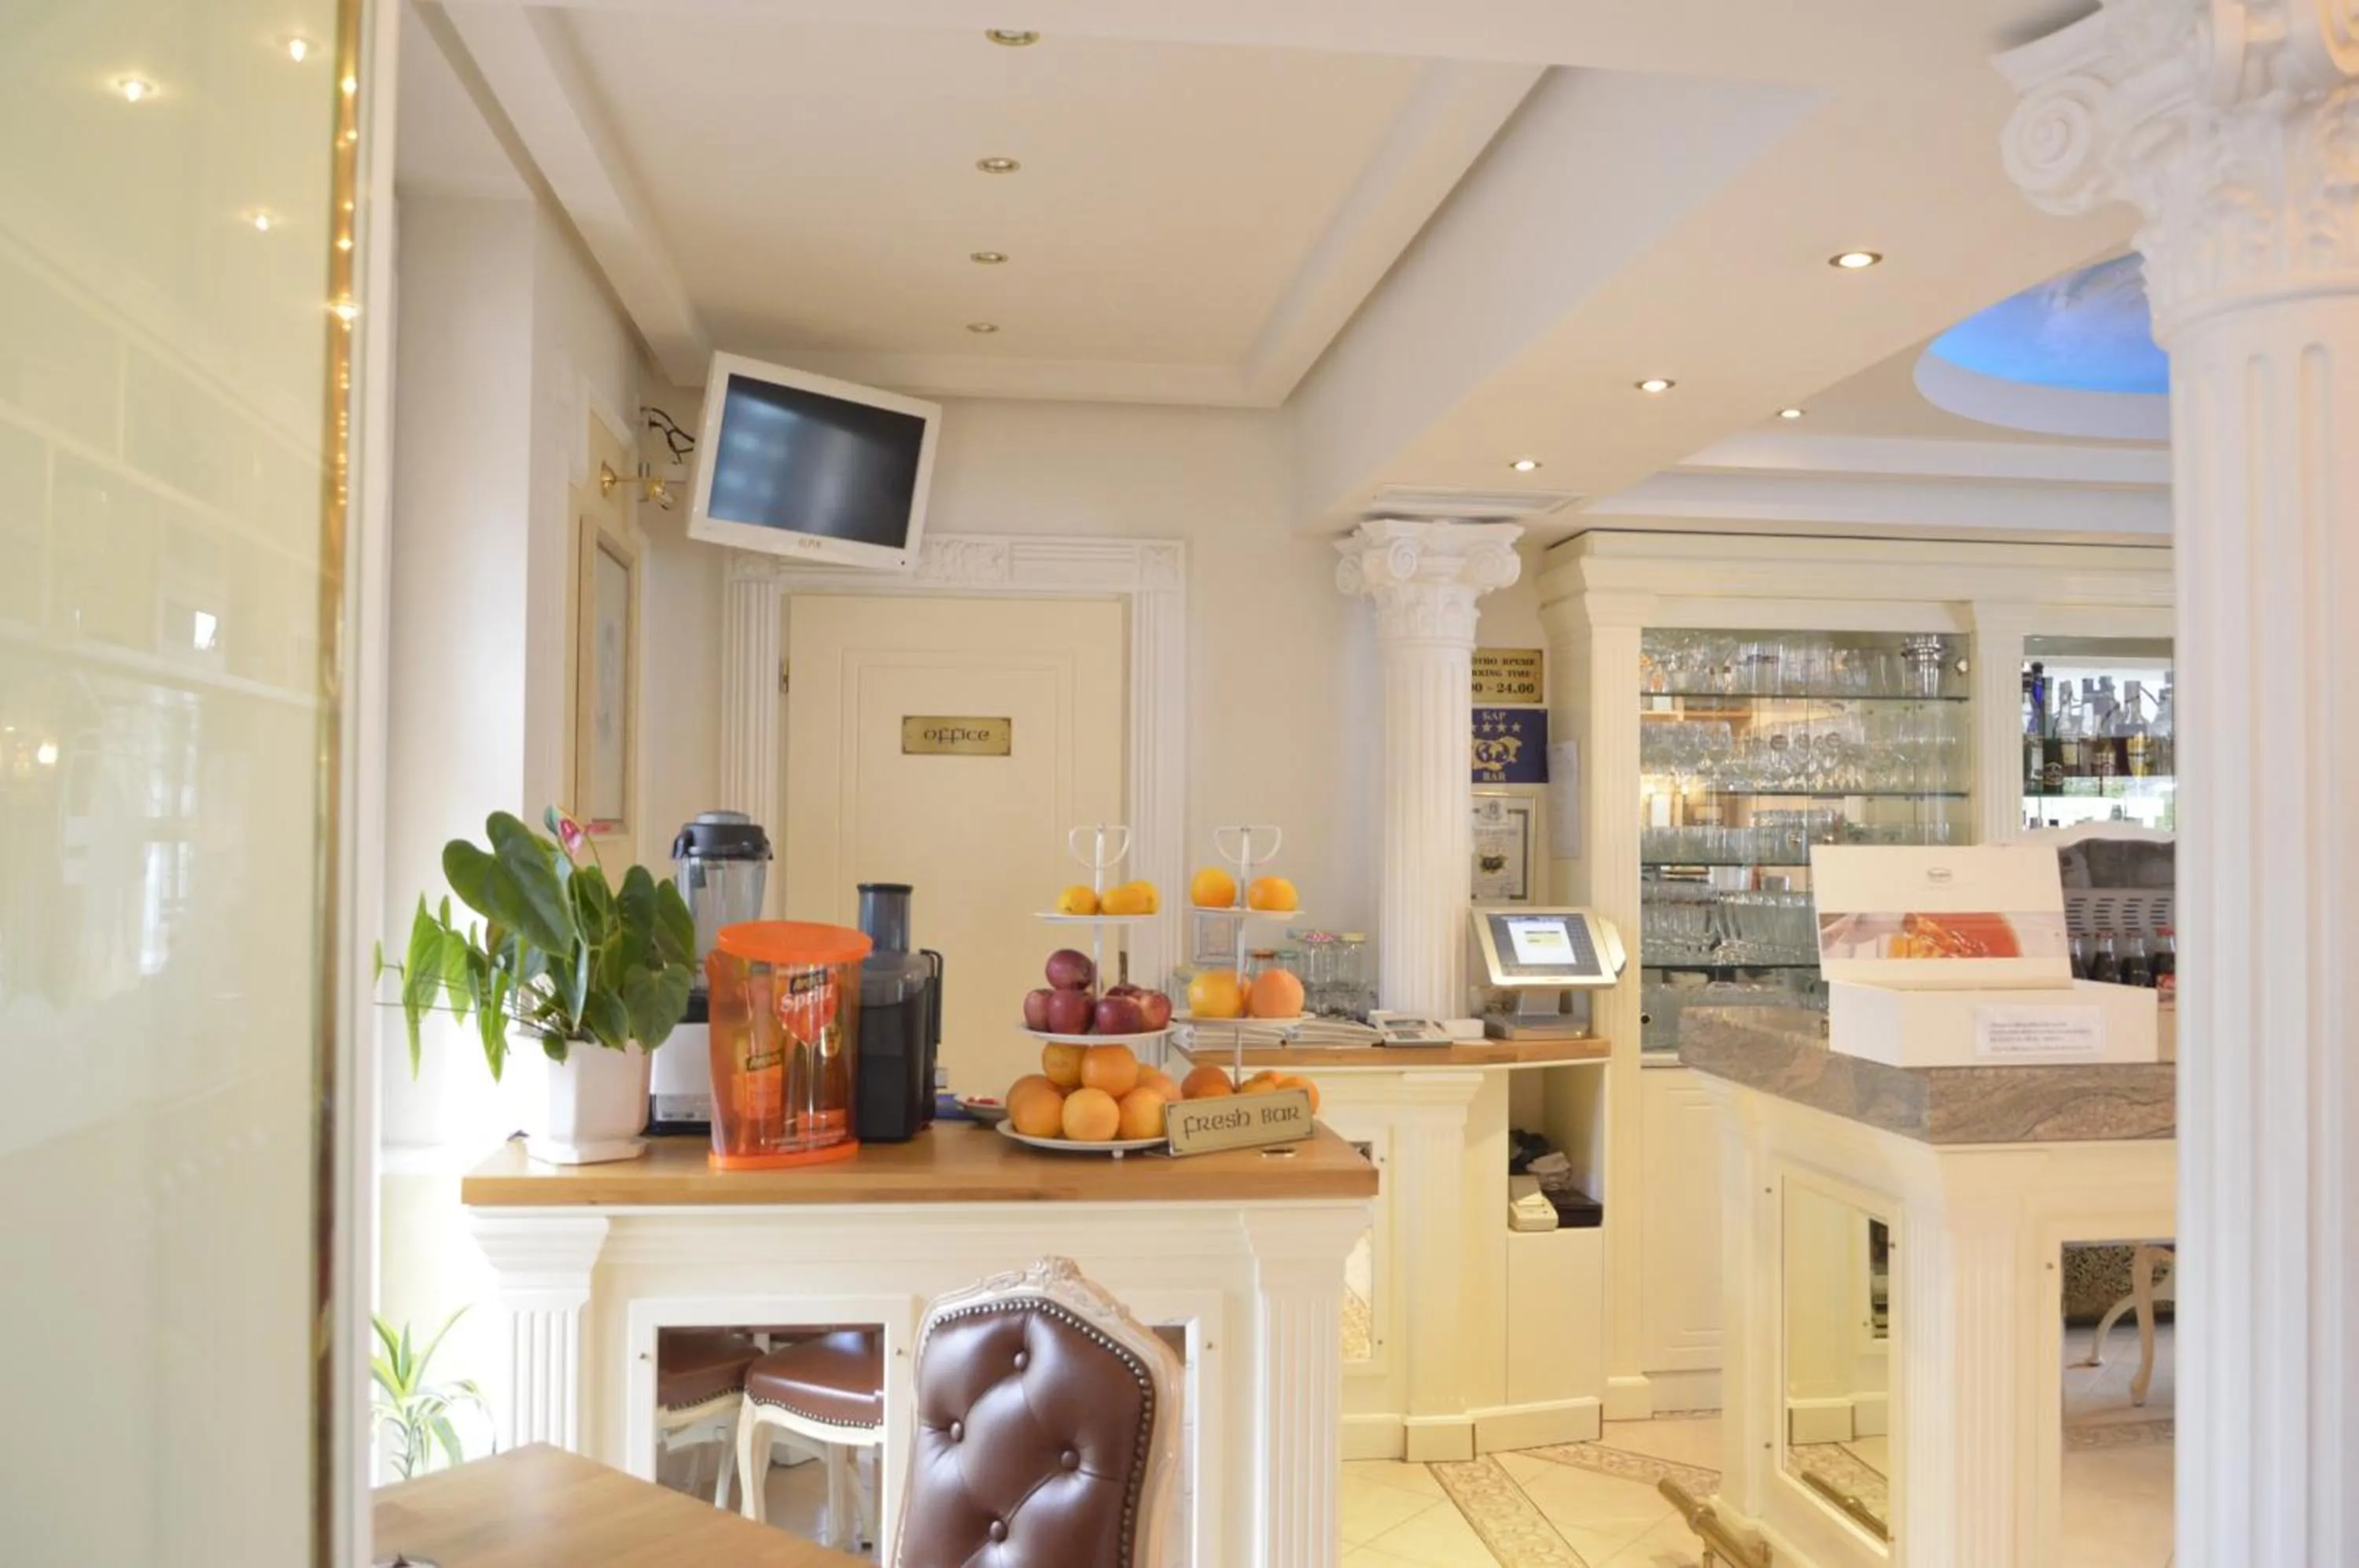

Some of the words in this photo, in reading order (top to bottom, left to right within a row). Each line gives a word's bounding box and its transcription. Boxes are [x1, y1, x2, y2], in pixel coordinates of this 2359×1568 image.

[1471, 668, 1503, 677] RKING
[1507, 669, 1529, 678] TIME
[1496, 682, 1535, 694] 24.00
[1481, 771, 1507, 782] BAR
